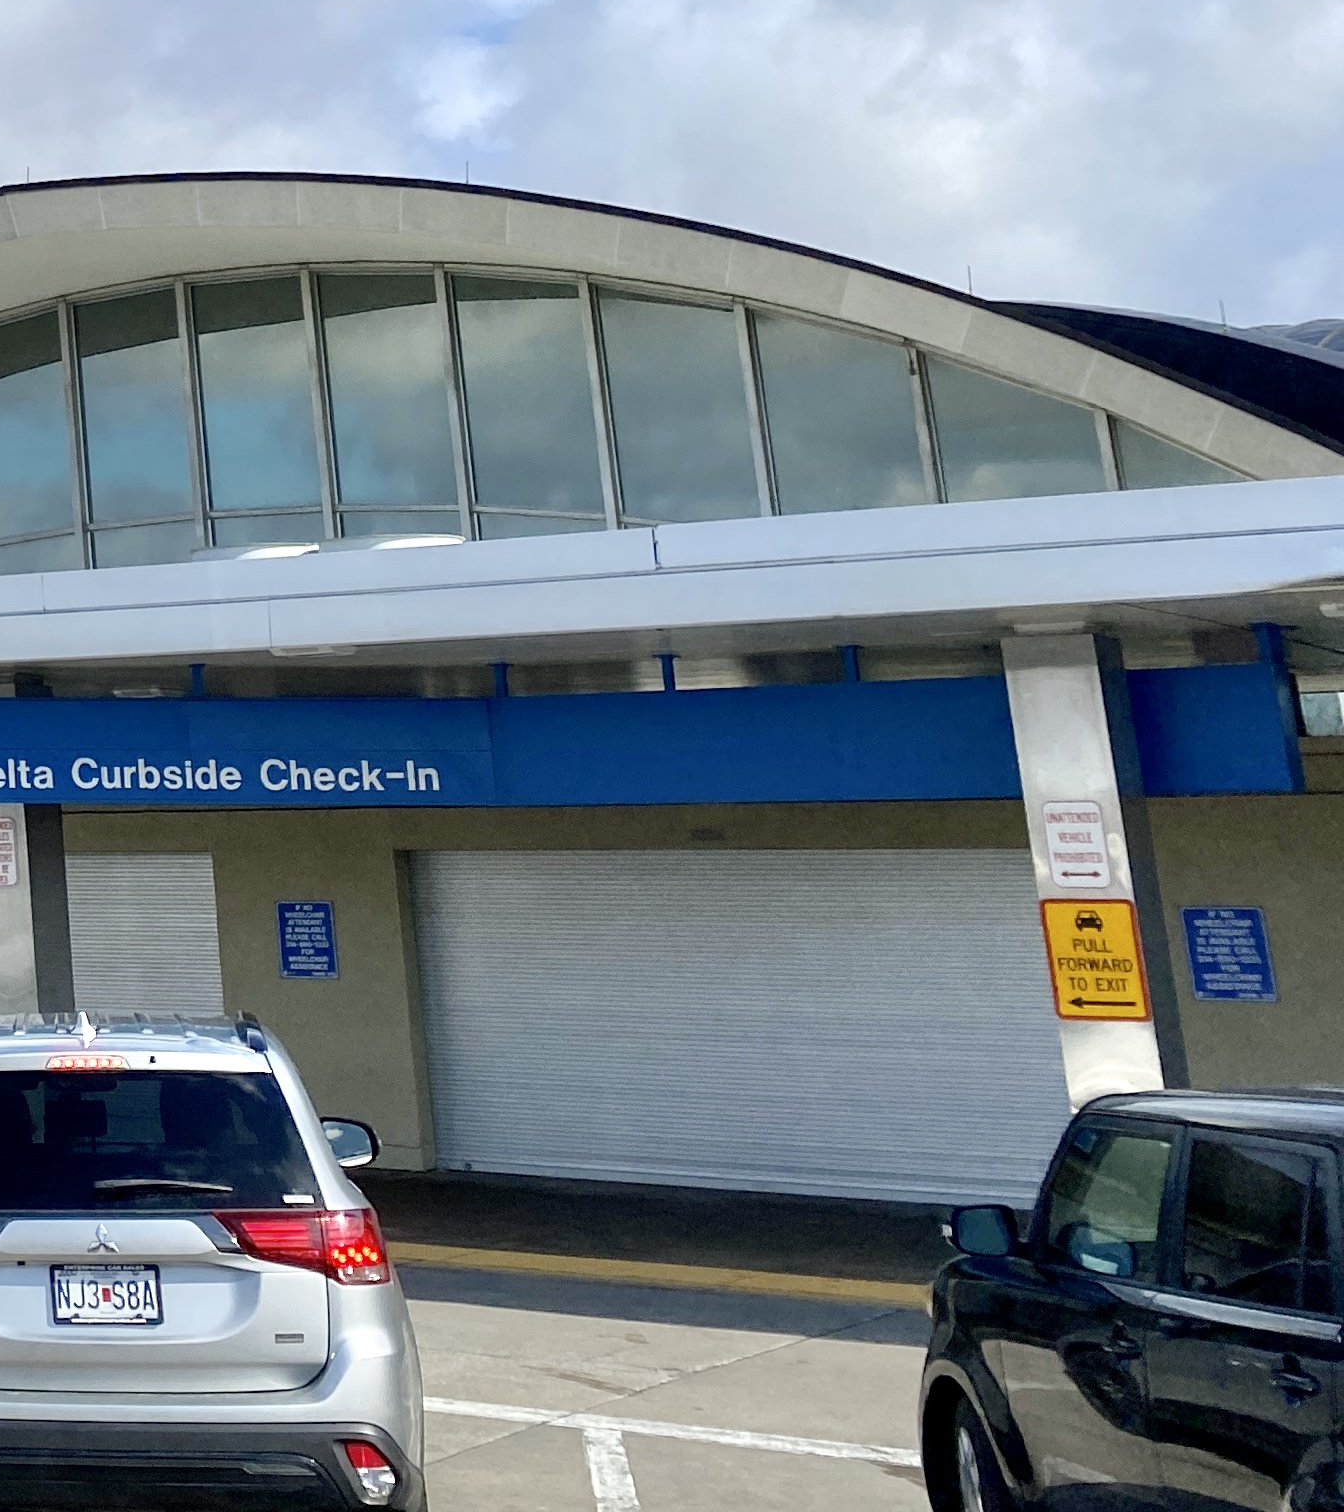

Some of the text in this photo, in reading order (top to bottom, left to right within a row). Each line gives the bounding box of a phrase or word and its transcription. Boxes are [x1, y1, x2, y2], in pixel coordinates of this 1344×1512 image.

[70, 757, 242, 791] Curbside
[259, 757, 440, 792] Check-In
[1072, 938, 1112, 954] PULL
[1057, 957, 1133, 973] FORWARD
[1068, 977, 1128, 993] TO EXIT
[56, 1278, 155, 1311] NJ3 S8A
